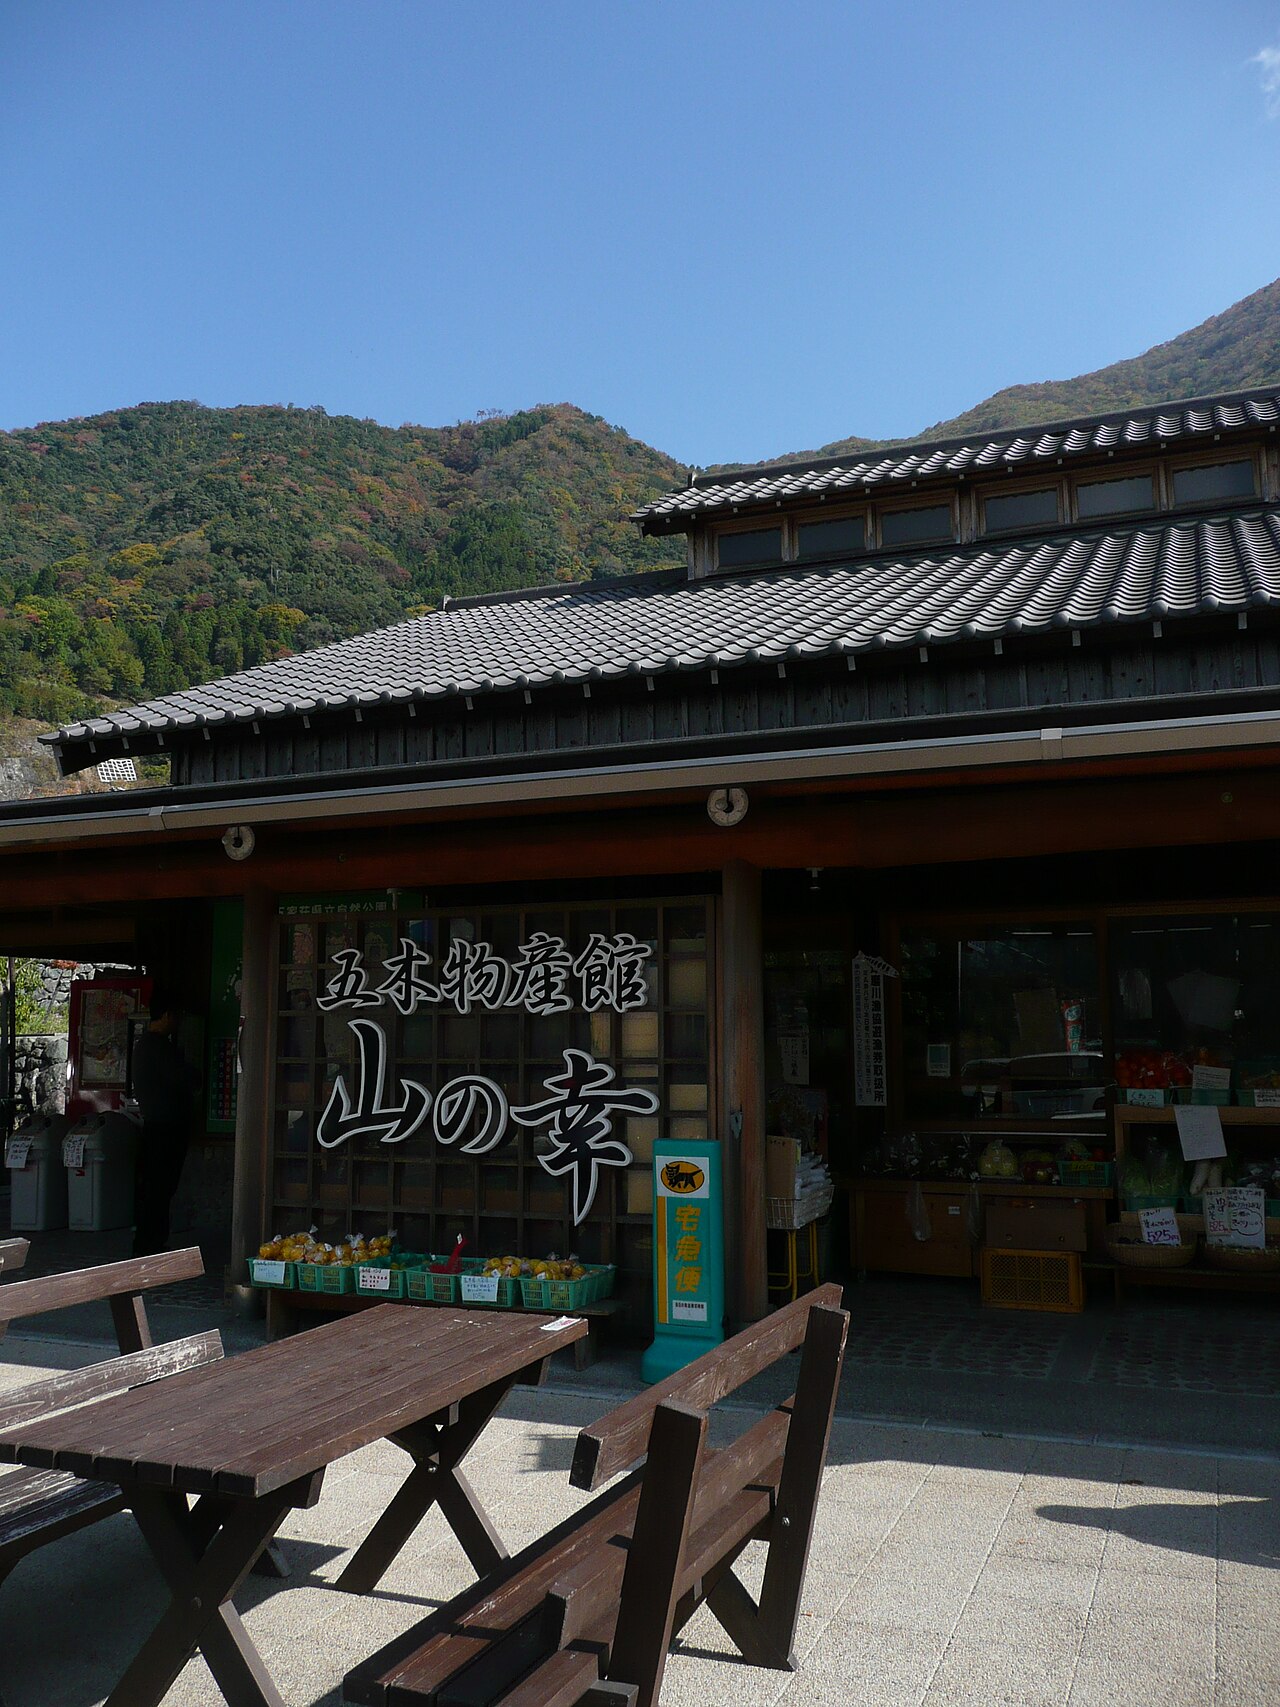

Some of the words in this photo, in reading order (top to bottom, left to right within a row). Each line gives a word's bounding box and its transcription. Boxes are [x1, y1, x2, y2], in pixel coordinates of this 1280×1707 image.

[316, 932, 654, 1016] 五木物産館
[316, 1019, 660, 1227] 山の幸
[673, 1204, 702, 1293] 宅急便
